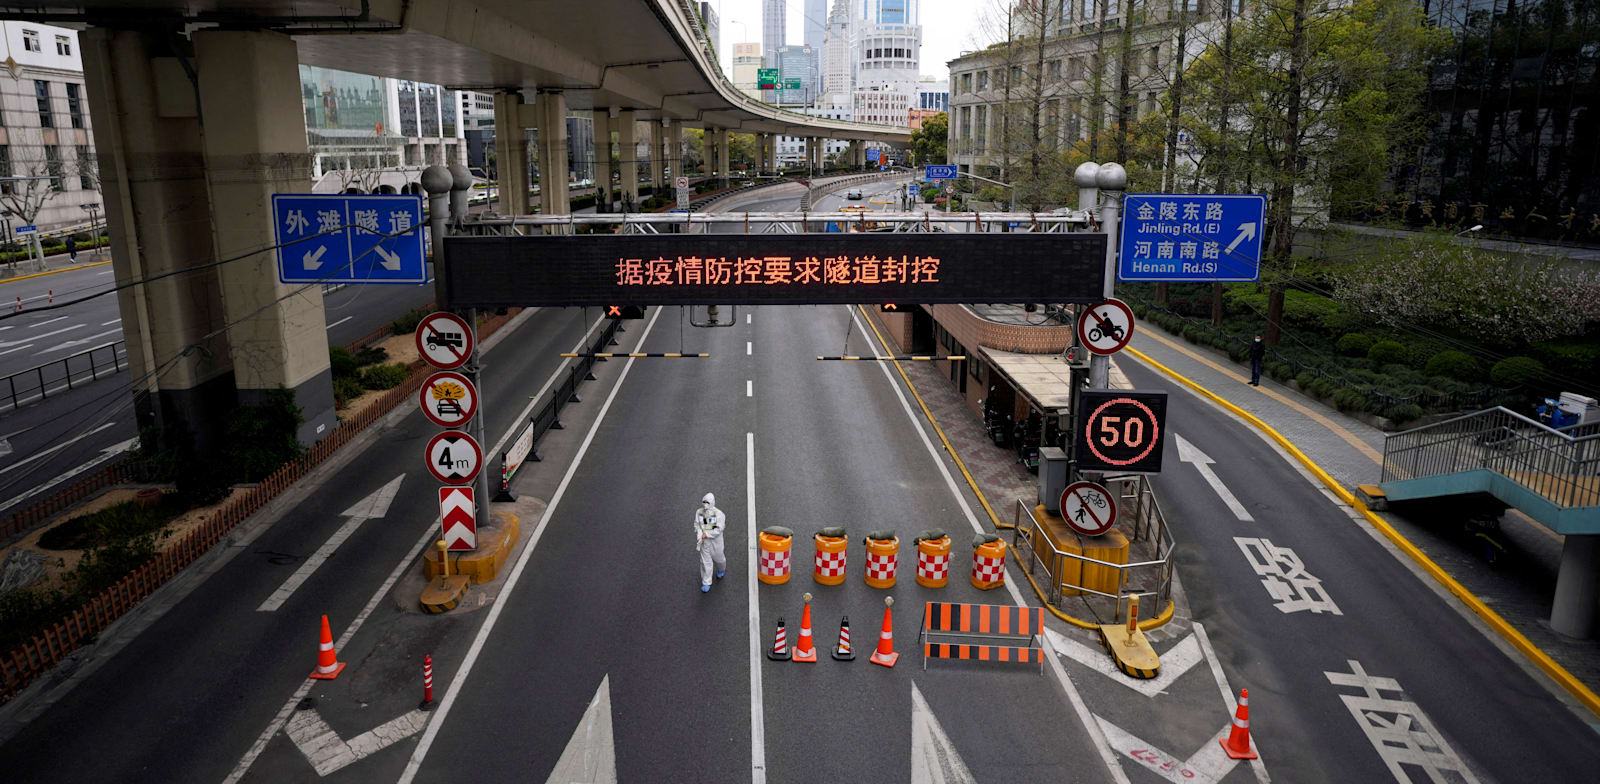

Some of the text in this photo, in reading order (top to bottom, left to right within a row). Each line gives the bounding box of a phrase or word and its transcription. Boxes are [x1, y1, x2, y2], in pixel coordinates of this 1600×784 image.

[1137, 202, 1224, 221] 金陵东路
[285, 209, 414, 236] 外滩 隧道
[1138, 223, 1180, 236] Jinling
[1133, 240, 1220, 260] 河南南路
[615, 255, 941, 285] 据疫情防控要求隧道封控
[1132, 261, 1176, 273] Henan
[1100, 416, 1144, 447] 50
